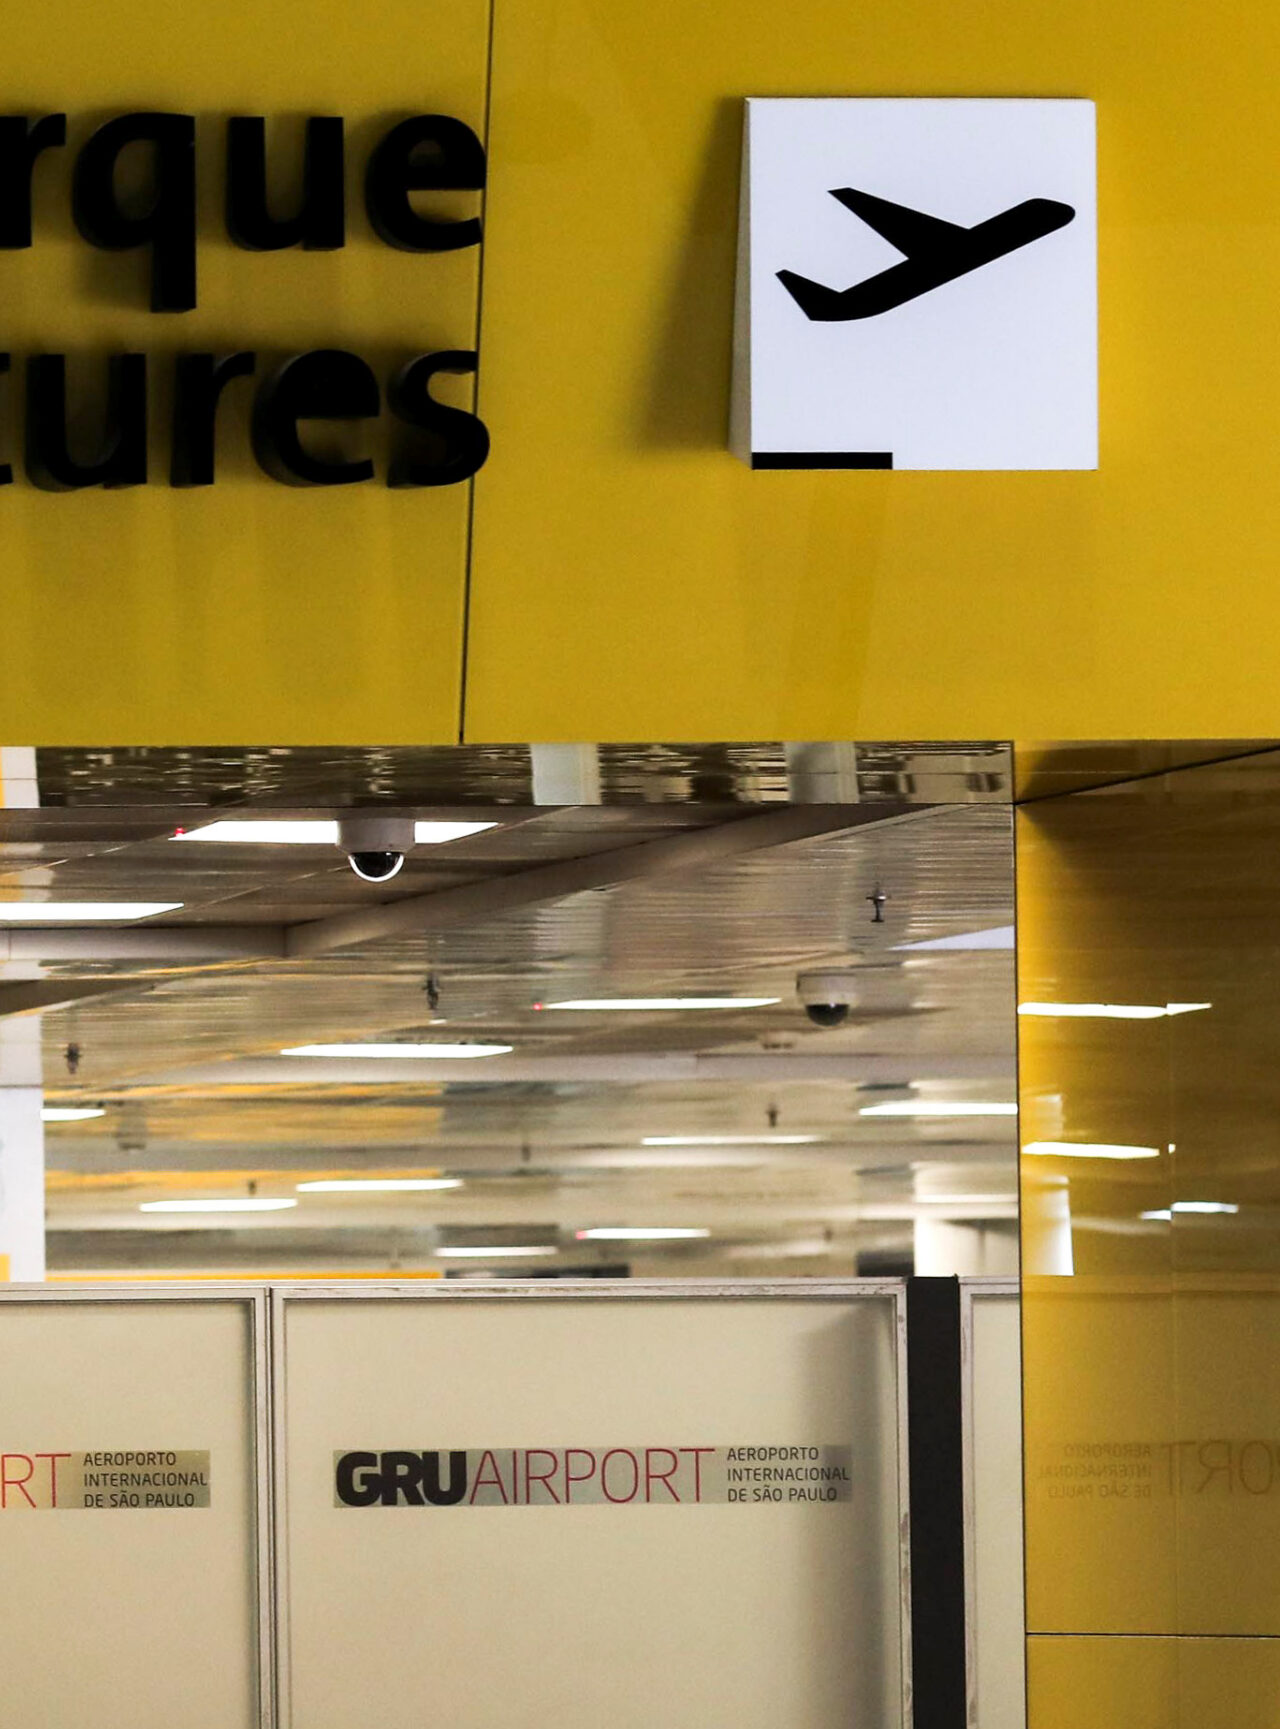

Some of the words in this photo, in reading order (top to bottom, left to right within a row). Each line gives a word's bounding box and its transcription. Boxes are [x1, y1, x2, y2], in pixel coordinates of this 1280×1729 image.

[83, 1452, 176, 1467] AEROPORTO
[727, 1447, 819, 1461] AEROPORTO
[84, 1472, 207, 1487] INTERNACIONAL
[728, 1467, 850, 1481] INTERNACIONAL
[84, 1494, 103, 1508] DE
[110, 1490, 140, 1508] SÃO
[146, 1493, 195, 1507] PAULO
[728, 1488, 747, 1502] DE
[753, 1485, 783, 1502] SÃO
[789, 1487, 837, 1501] PAULO
